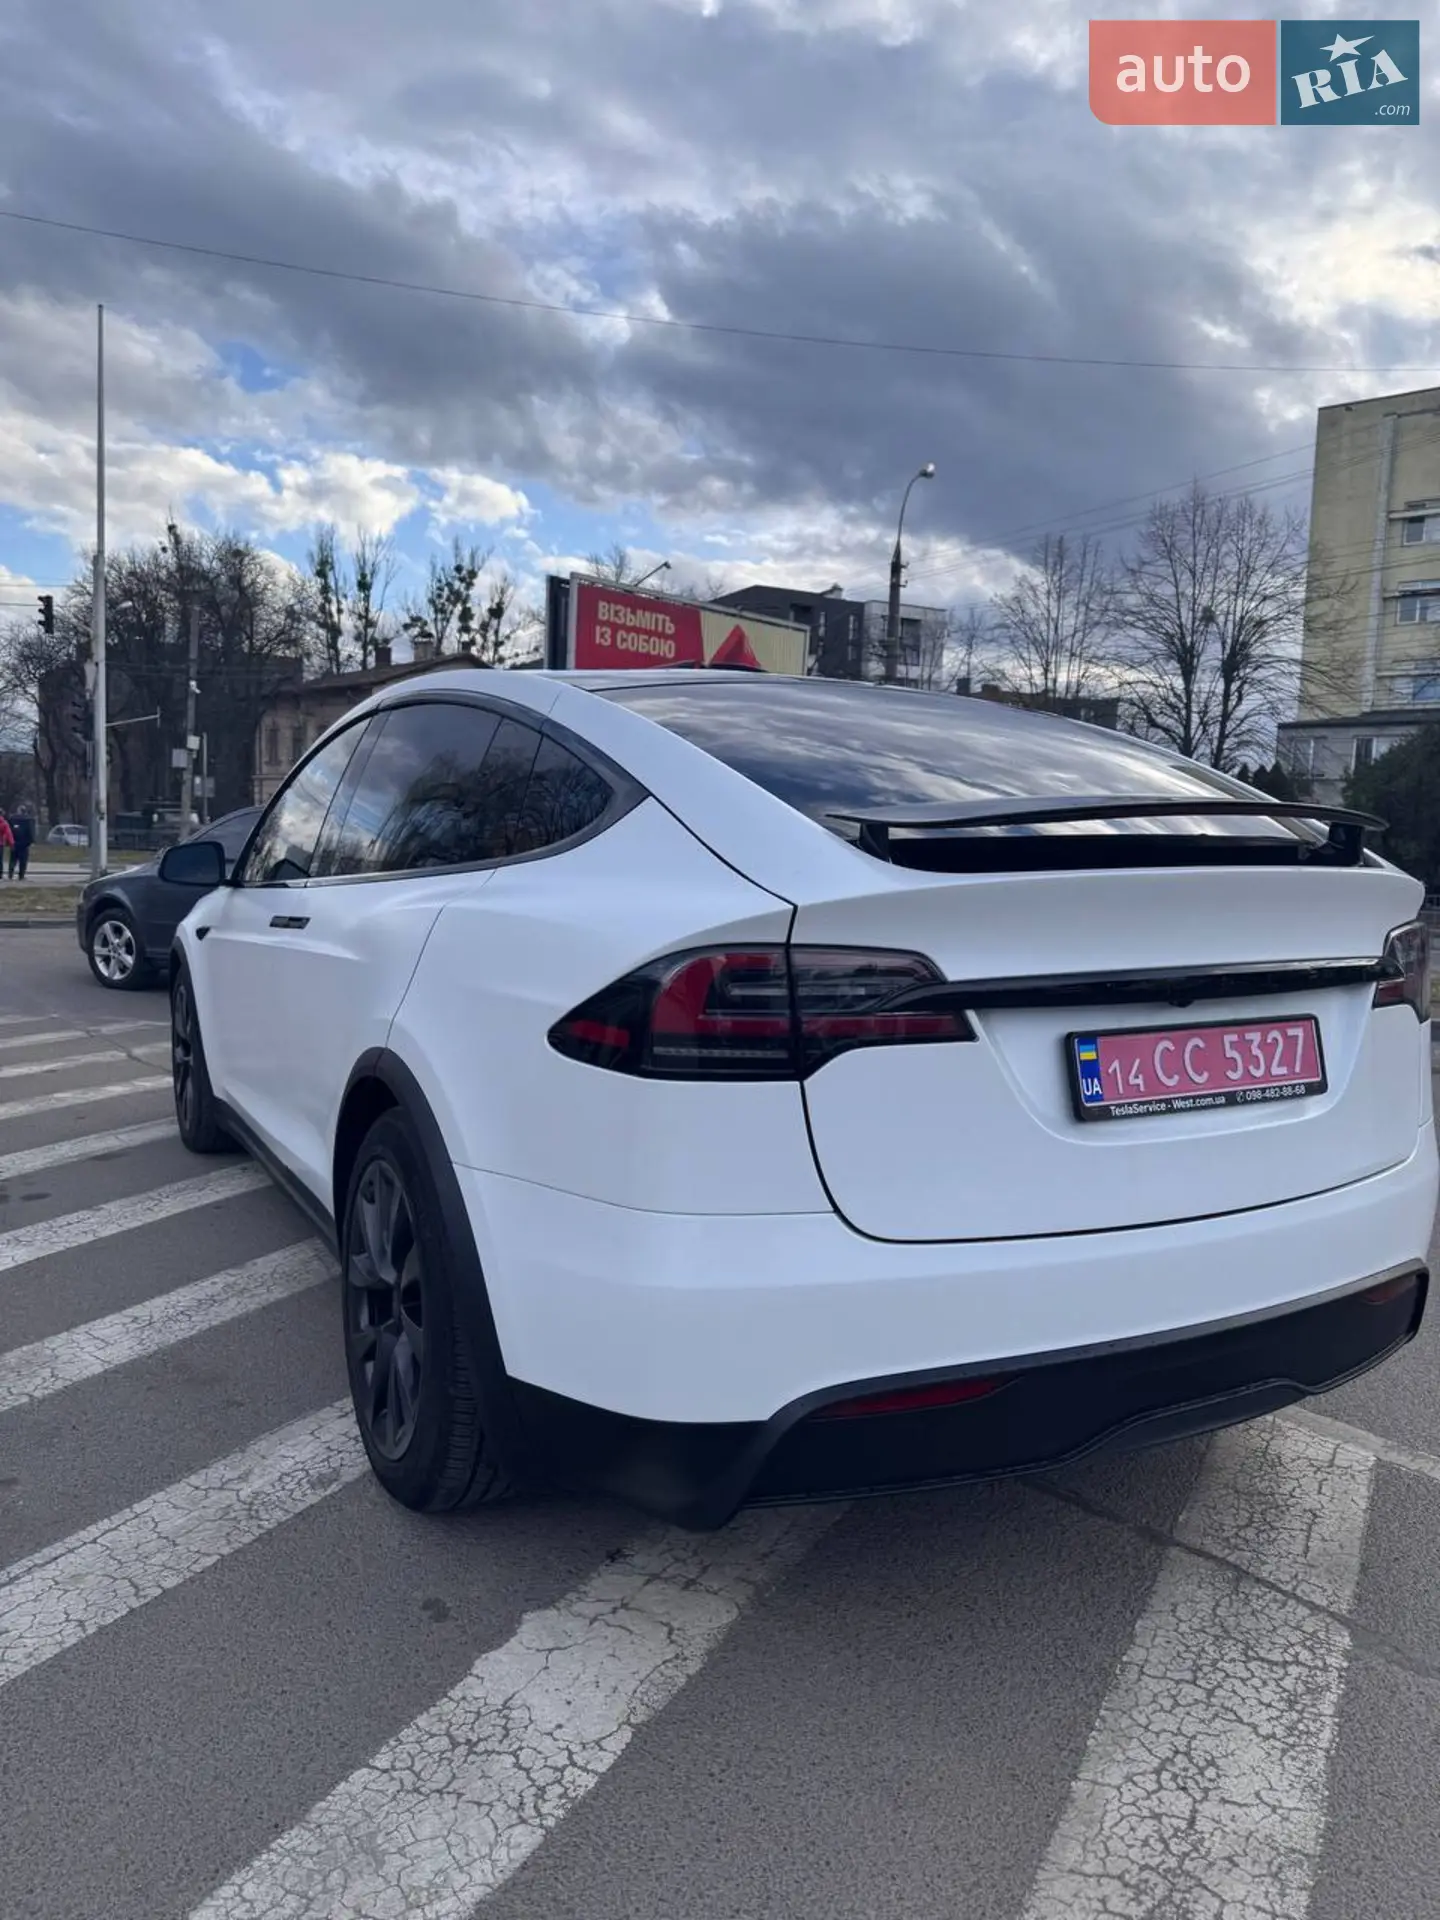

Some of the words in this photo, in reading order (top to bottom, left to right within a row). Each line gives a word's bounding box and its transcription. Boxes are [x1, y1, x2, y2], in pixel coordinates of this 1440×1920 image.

[598, 600, 676, 635] ВІЗЬМІТЬ
[595, 625, 612, 646] ІЗ
[616, 629, 676, 659] СОБОЮ
[1107, 1057, 1146, 1095] 14
[1153, 1037, 1209, 1087] CC
[1223, 1027, 1305, 1081] 5327
[1082, 1078, 1102, 1096] UA
